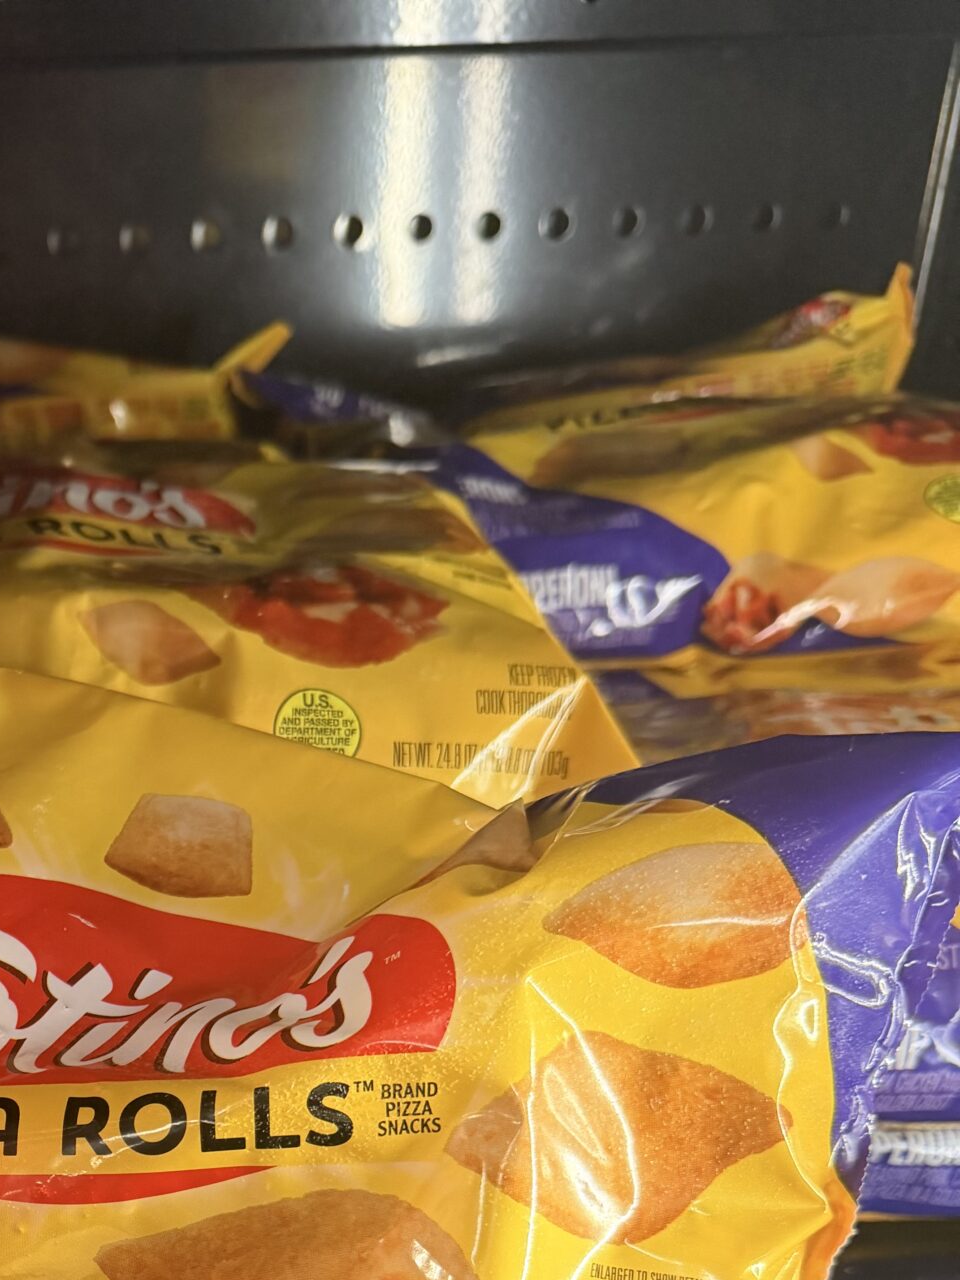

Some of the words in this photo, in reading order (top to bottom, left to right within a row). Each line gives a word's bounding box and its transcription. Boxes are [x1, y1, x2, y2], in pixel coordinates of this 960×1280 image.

[508, 663, 533, 686] KEEP
[302, 692, 333, 709] U.S.
[476, 689, 506, 714] COOK
[292, 708, 343, 718] INSPECTED
[279, 726, 342, 736] DEPARTMENT
[344, 728, 357, 737] OF
[281, 717, 300, 726] AND
[303, 718, 340, 727] PASSED
[342, 719, 354, 728] BY
[380, 1081, 439, 1100] BRAND
[385, 1100, 433, 1118] PIZZA
[61, 1082, 354, 1157] ROLLS
[377, 1117, 442, 1137] SNACKS
